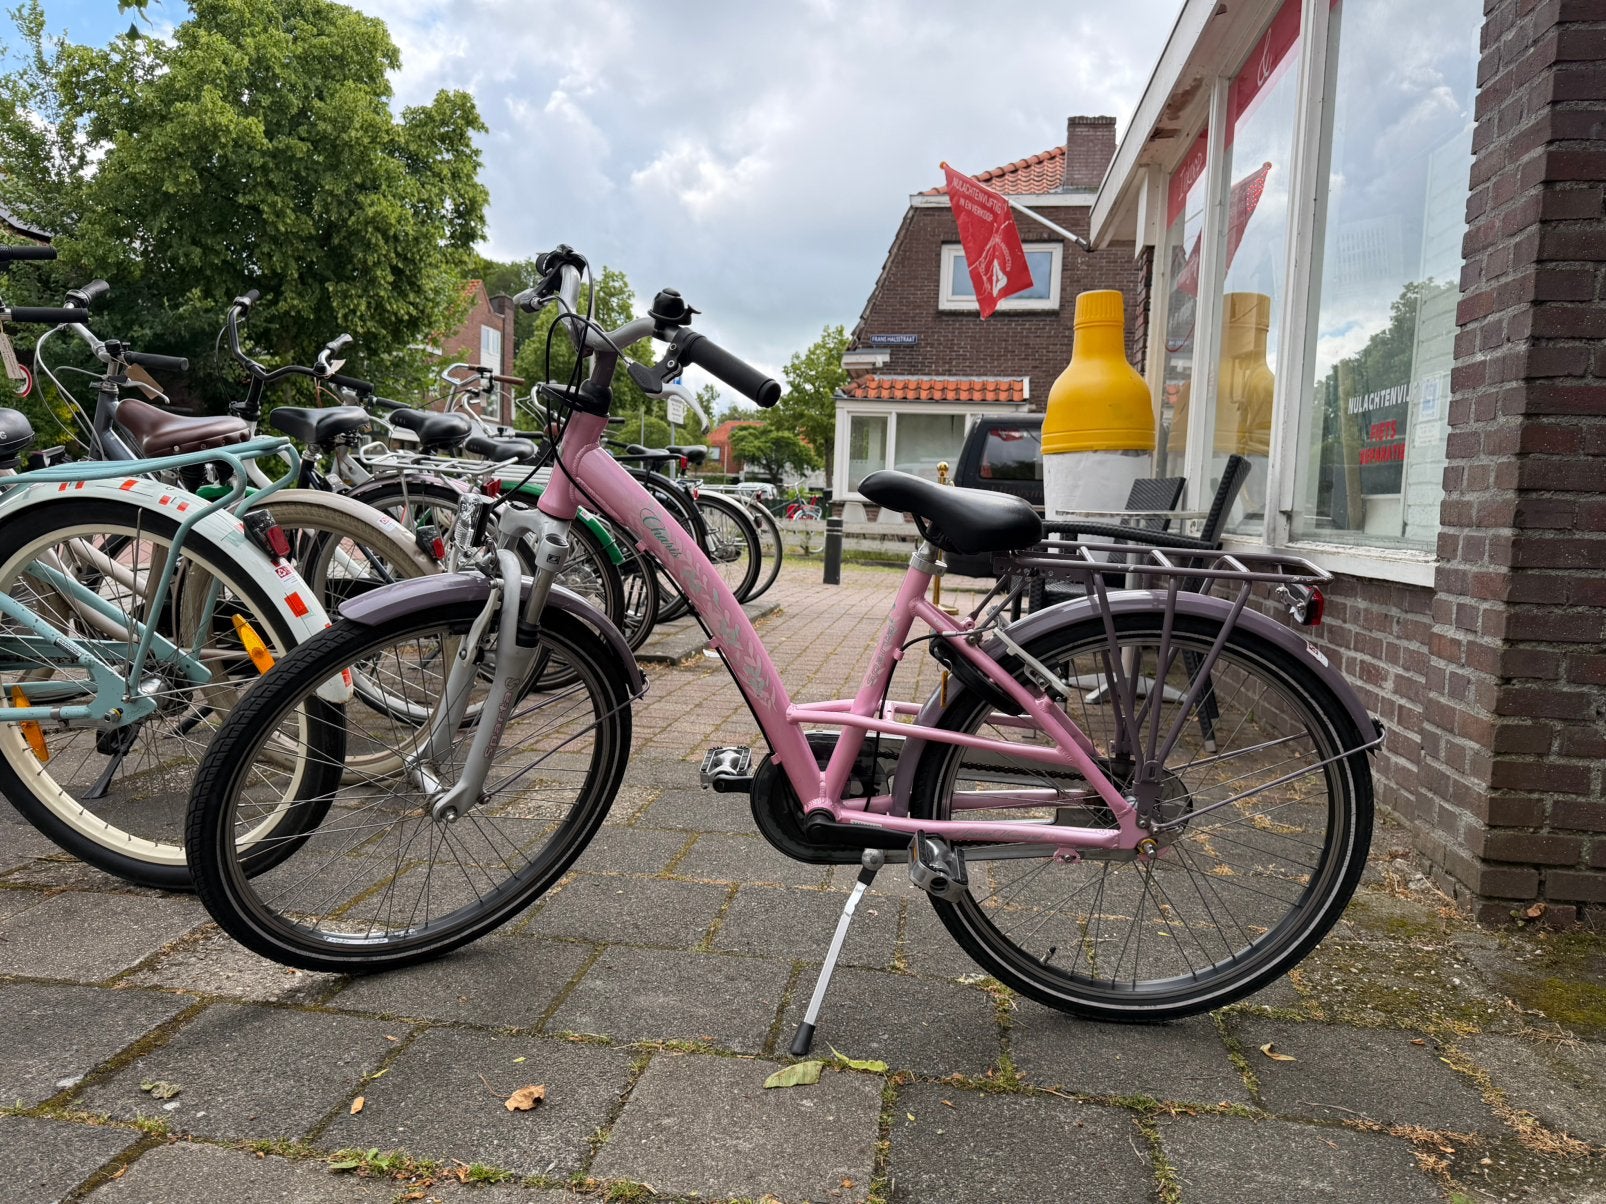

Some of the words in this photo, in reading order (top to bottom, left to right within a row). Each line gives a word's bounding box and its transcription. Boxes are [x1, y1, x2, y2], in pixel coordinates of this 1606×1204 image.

[952, 177, 1001, 214] NULACHTENVIJFTIG
[972, 205, 993, 222] VERKOOP
[1369, 418, 1397, 442] FIETS
